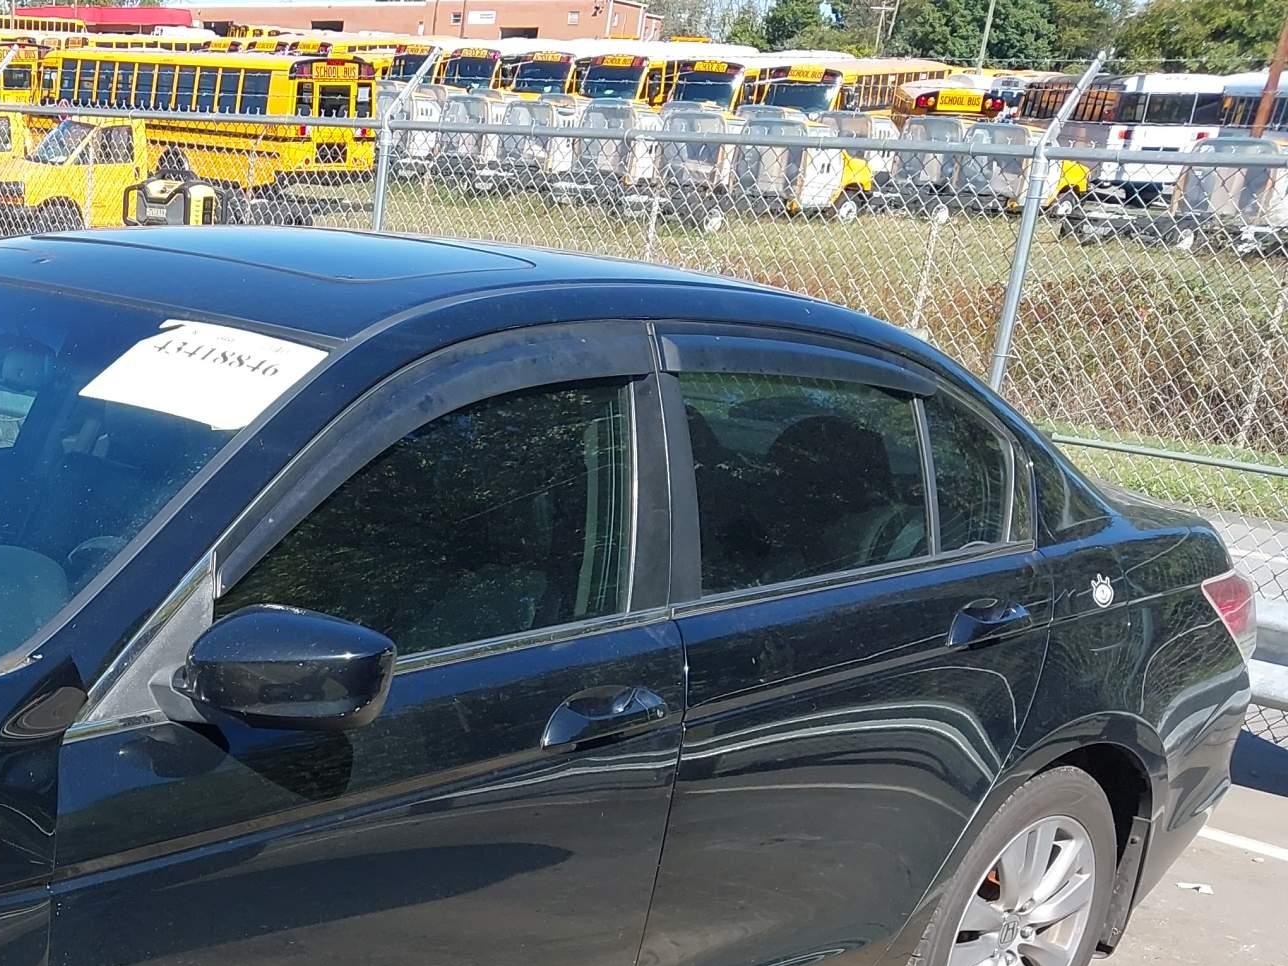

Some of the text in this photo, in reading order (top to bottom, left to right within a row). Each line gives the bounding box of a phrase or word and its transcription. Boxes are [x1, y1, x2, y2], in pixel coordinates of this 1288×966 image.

[315, 65, 357, 79] SCHOOL BUS
[939, 95, 982, 107] SCHOOL BUS
[153, 339, 280, 377] 43418846
